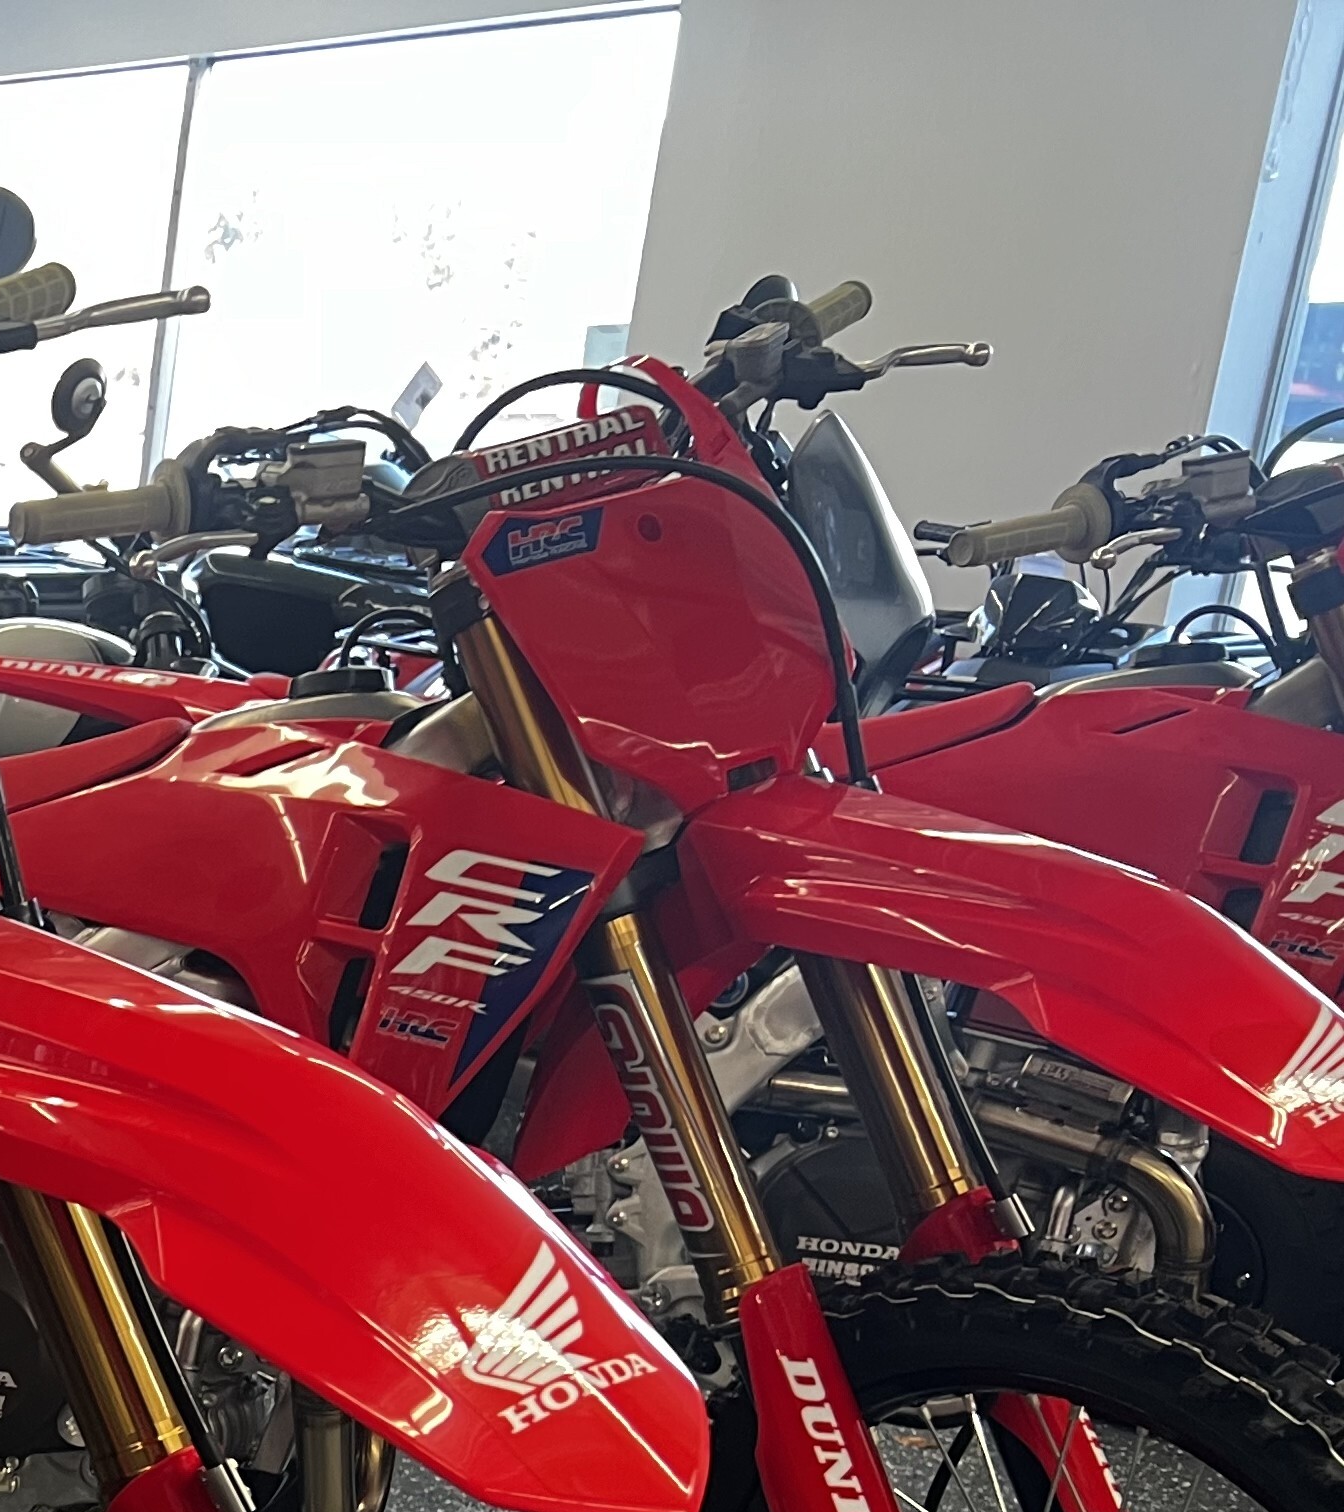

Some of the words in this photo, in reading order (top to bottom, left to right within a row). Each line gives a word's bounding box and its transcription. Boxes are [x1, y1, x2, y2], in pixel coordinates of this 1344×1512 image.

[485, 412, 645, 474] RENTHAL
[507, 515, 586, 561] HRC
[389, 849, 564, 976] CRF
[796, 1235, 901, 1261] HONDA
[496, 1352, 659, 1435] HONDA
